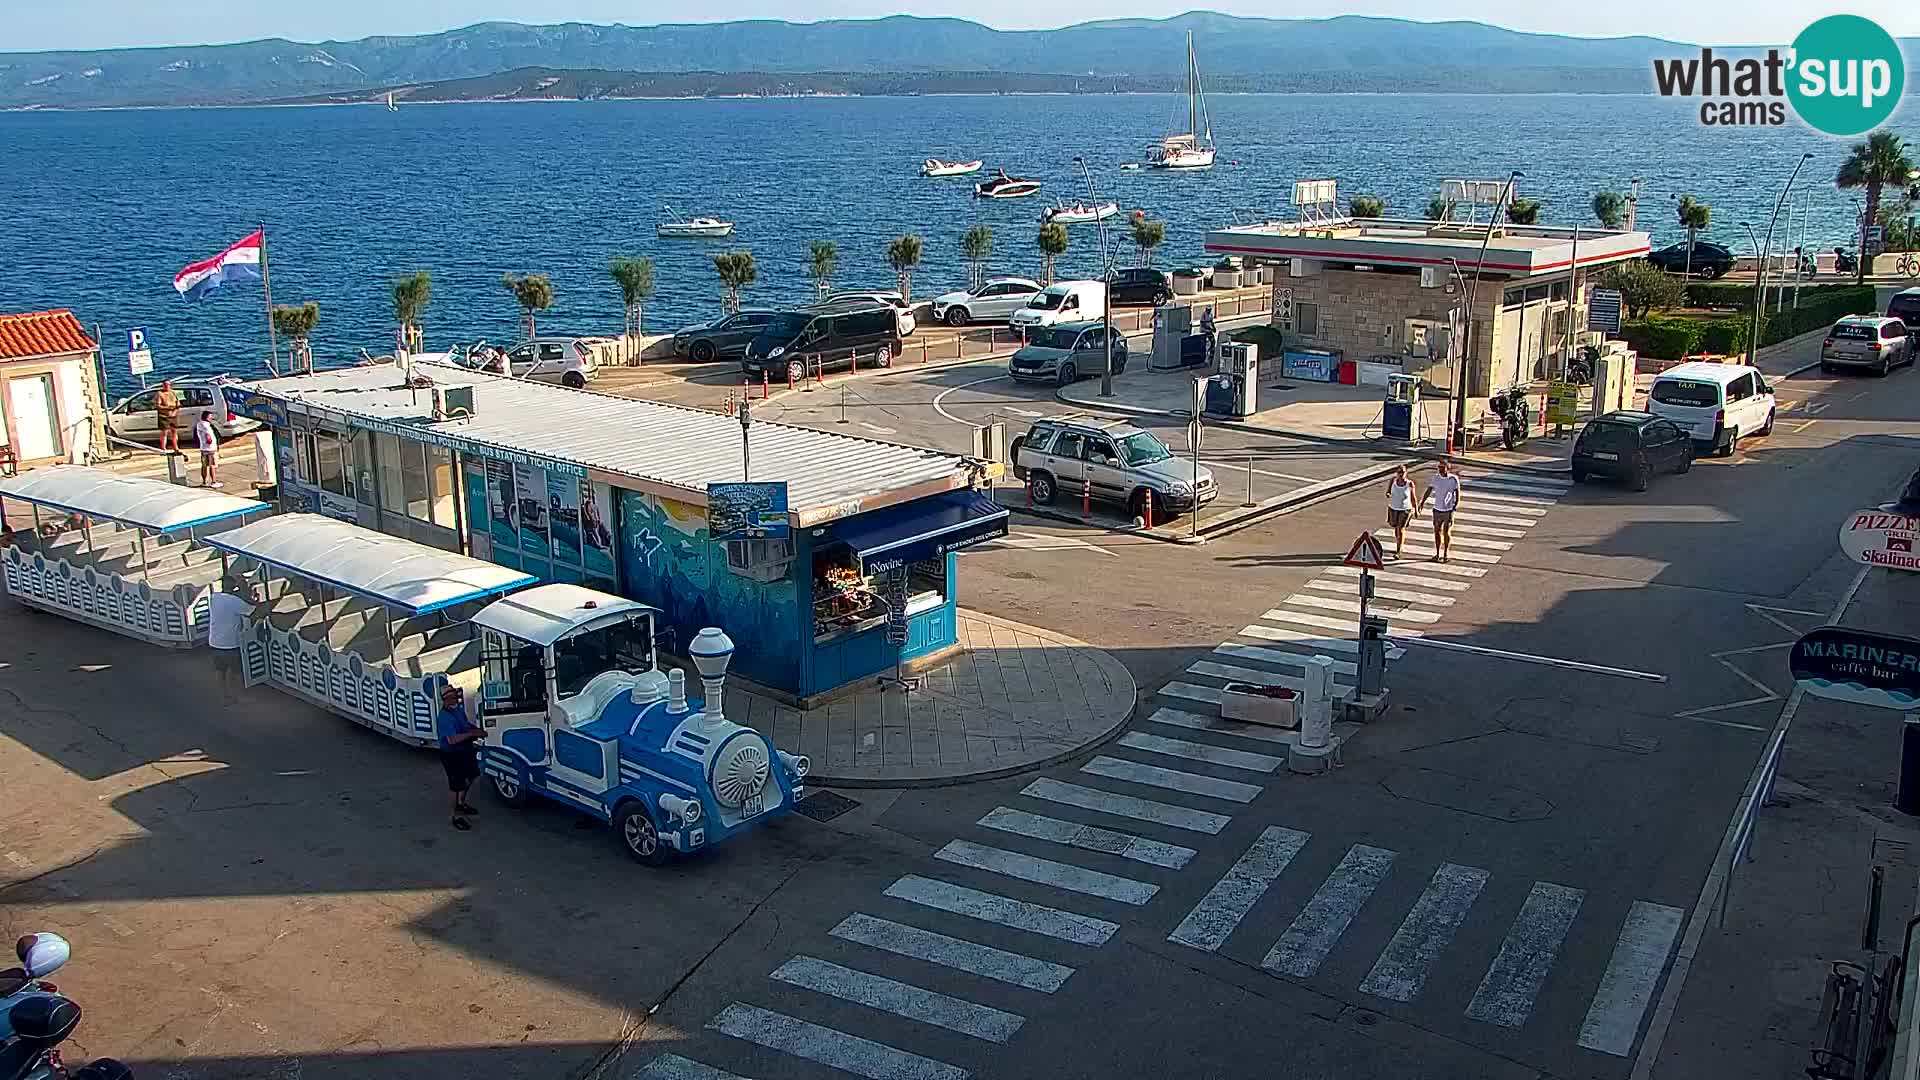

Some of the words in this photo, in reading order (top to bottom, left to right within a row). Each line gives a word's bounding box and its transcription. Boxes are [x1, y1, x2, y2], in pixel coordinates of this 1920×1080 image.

[131, 331, 144, 350] P
[1677, 382, 1696, 390] TAXI
[479, 446, 493, 457] BUS
[496, 450, 527, 464] STATION
[529, 457, 555, 471] TICKET
[556, 463, 584, 476] OFFICE
[1850, 515, 1920, 532] PIZZE
[870, 558, 903, 575] Novine
[1871, 664, 1899, 680] bar
